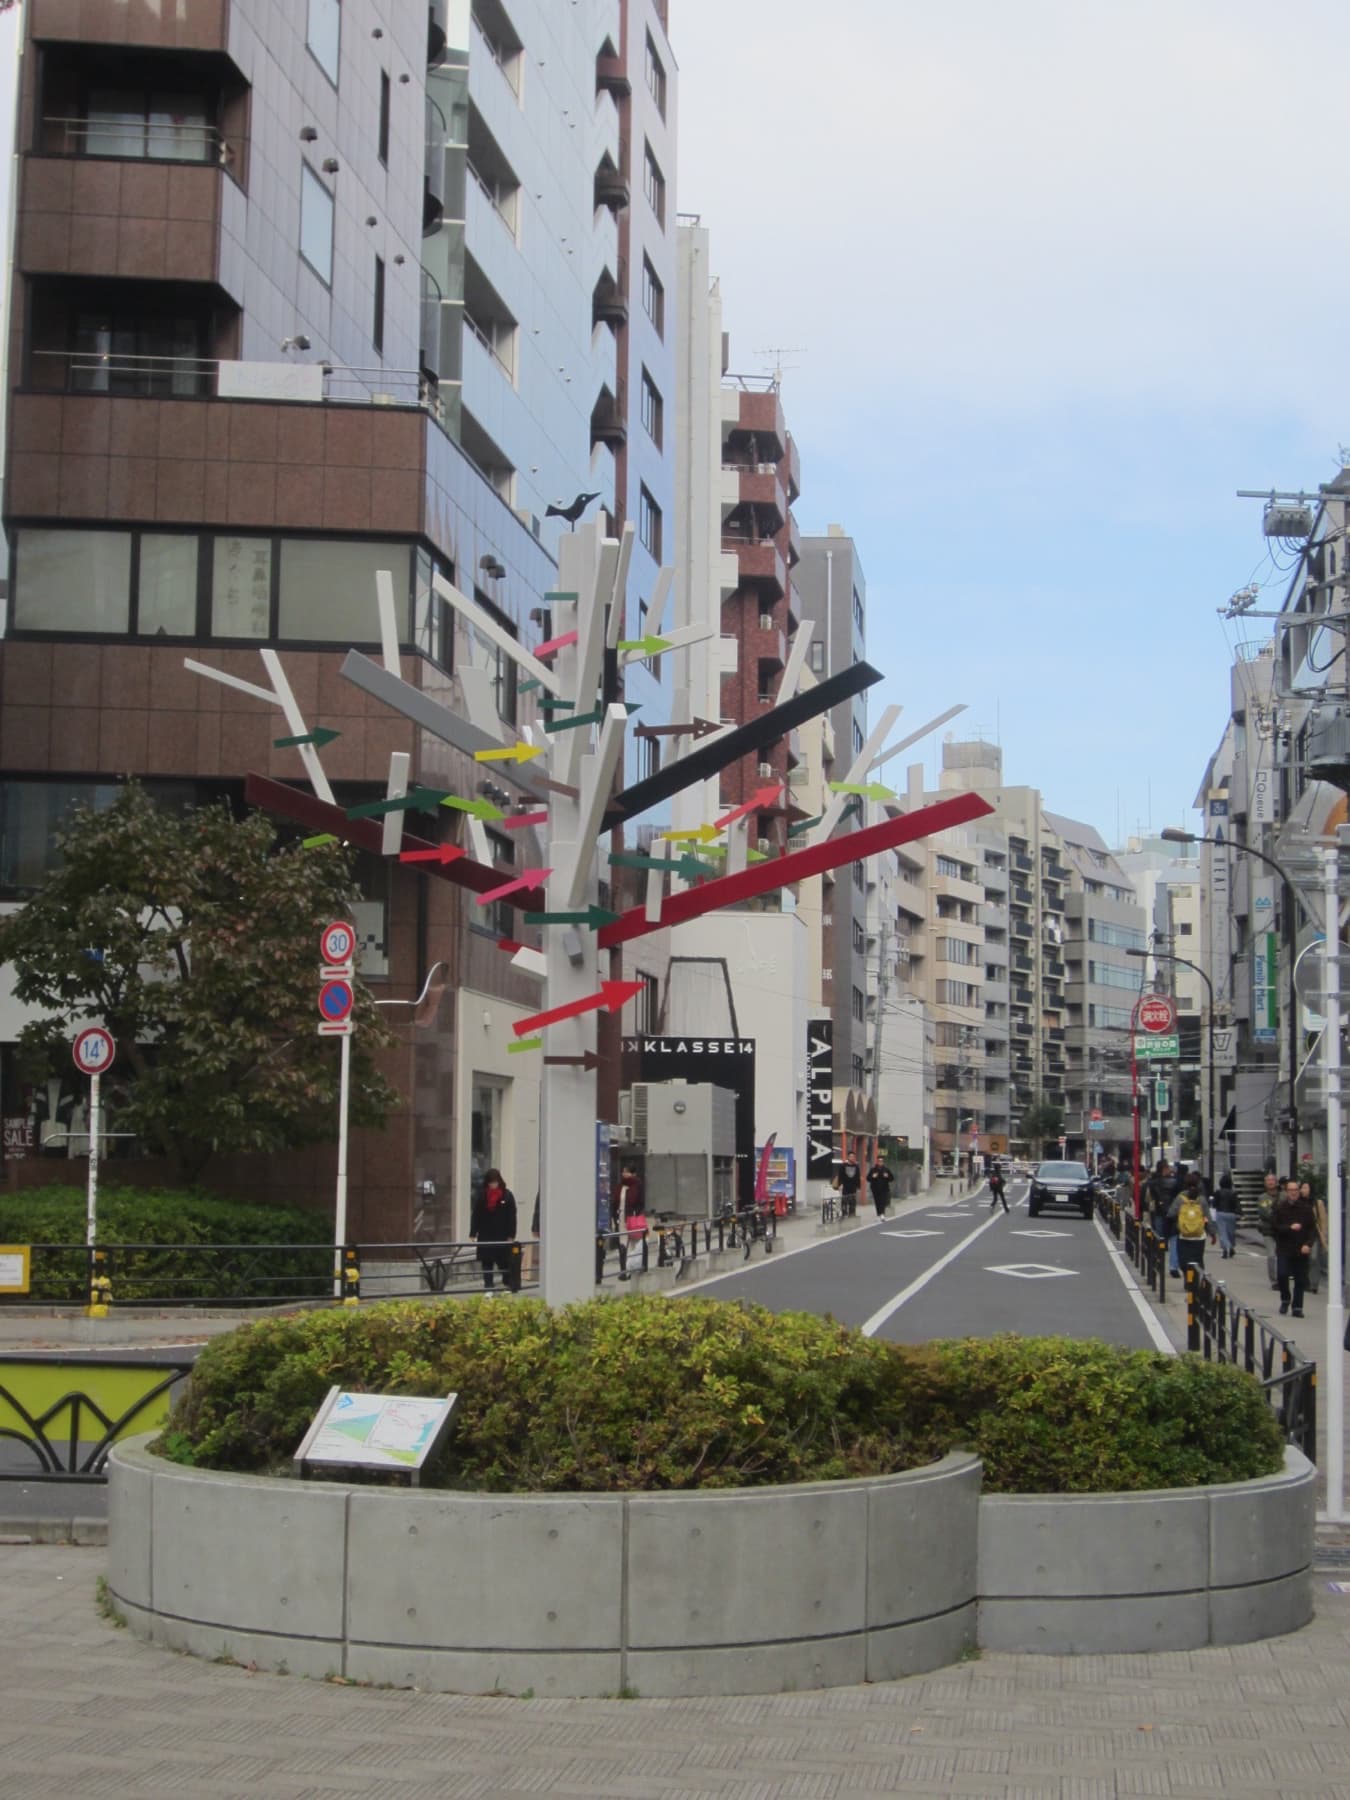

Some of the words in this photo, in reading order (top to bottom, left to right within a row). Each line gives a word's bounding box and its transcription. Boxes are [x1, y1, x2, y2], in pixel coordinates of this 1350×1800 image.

[329, 934, 347, 953] 30
[644, 1041, 753, 1054] KLASSE14
[811, 1037, 833, 1161] ALPHA
[4, 1130, 33, 1146] SALE
